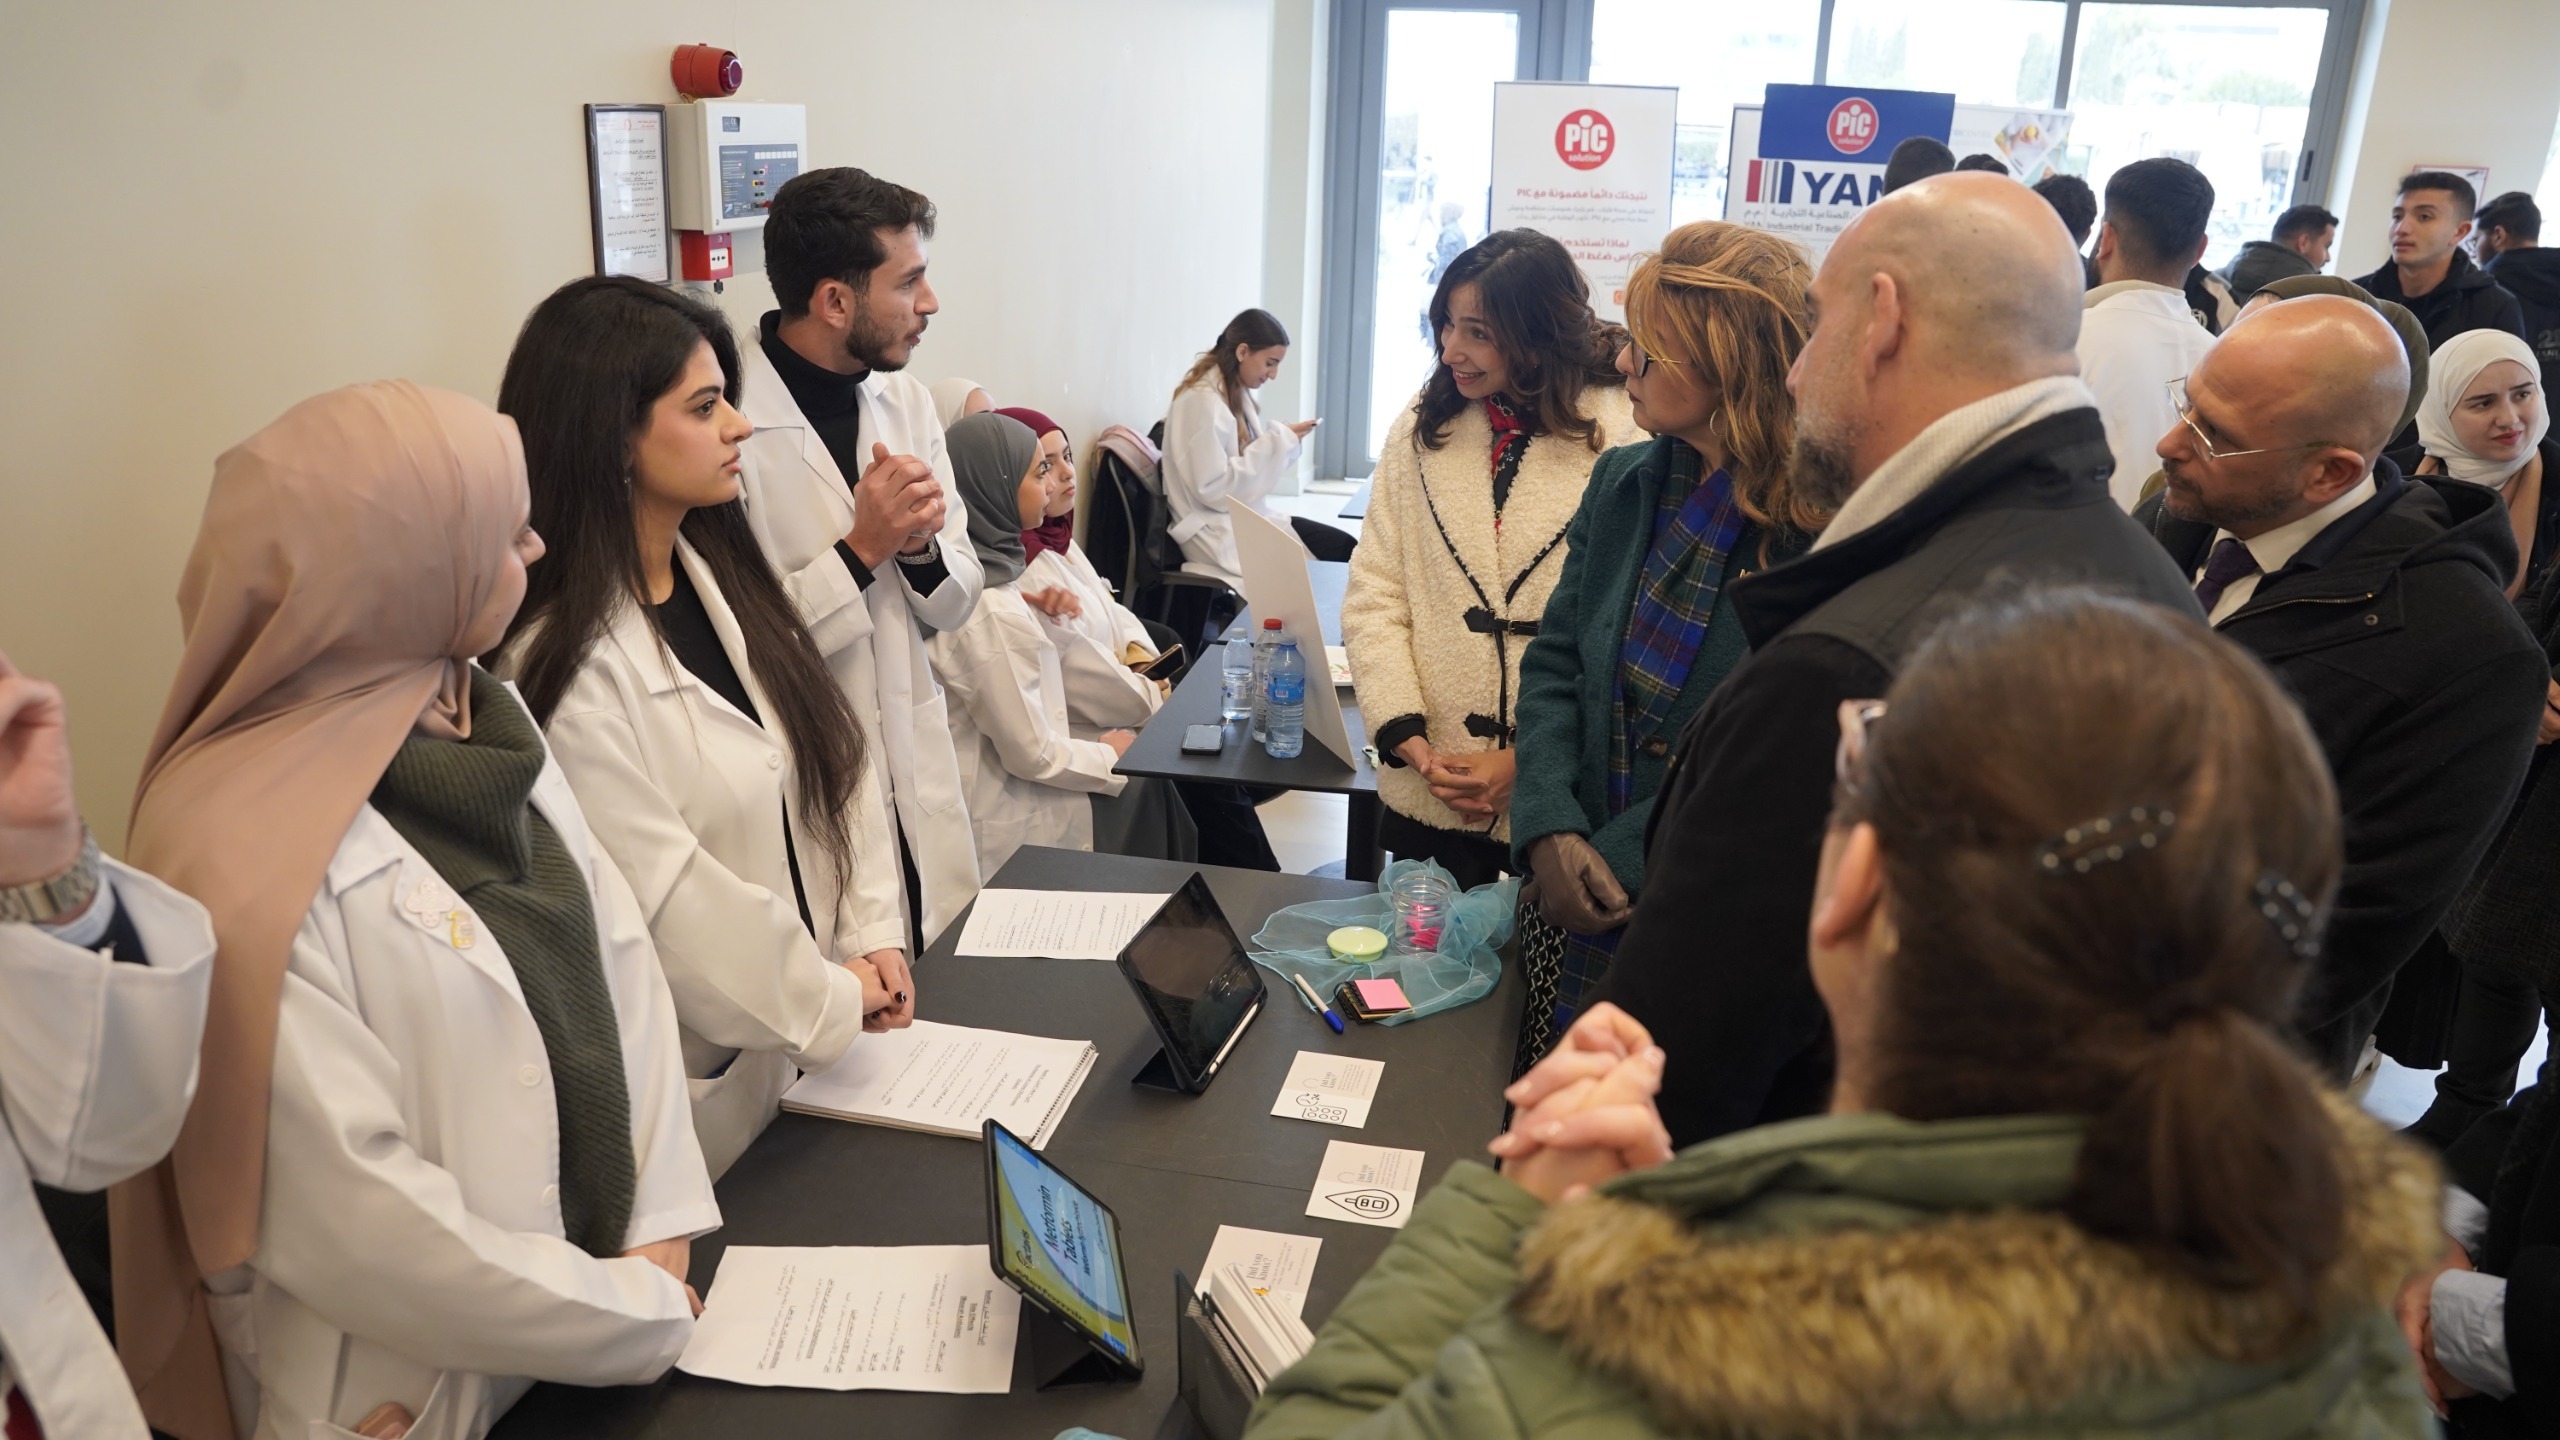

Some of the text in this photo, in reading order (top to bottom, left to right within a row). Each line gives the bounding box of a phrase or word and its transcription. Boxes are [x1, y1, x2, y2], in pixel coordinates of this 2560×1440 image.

[1836, 103, 1871, 138] PiC
[1564, 114, 1609, 152] PiC
[1568, 153, 1602, 164] solution
[1517, 188, 1532, 197] PIC
[1766, 221, 1813, 232] Industrial
[1606, 238, 1630, 248] لماذا
[1037, 1184, 1060, 1253] Metformin
[1060, 1217, 1078, 1265] Tablets
[1246, 1266, 1258, 1280] Did
[1256, 1257, 1273, 1281] know?
